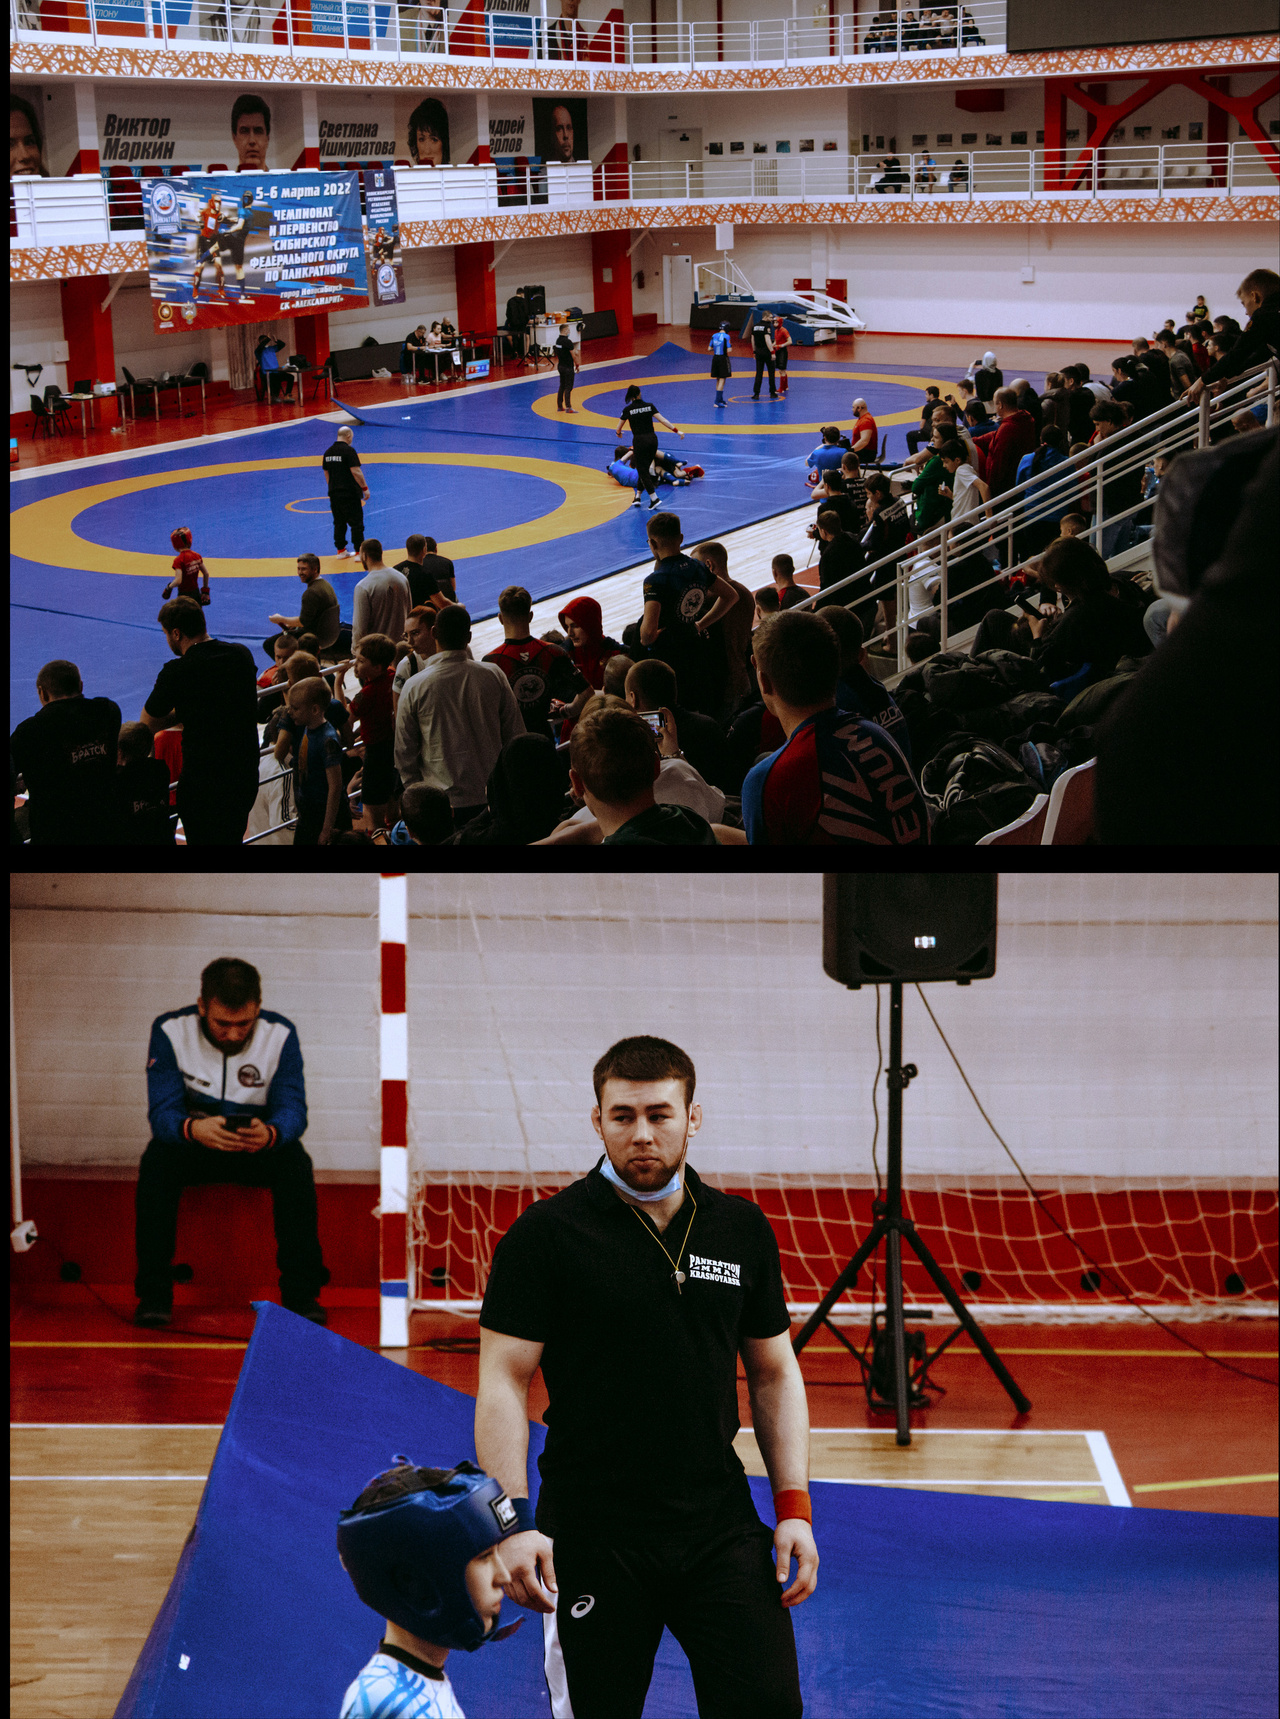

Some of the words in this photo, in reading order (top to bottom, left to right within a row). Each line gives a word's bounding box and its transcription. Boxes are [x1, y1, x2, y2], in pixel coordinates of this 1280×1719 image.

[335, 4, 369, 14] ПОЕДИТЕЛЬ
[104, 113, 172, 138] Виктор
[319, 120, 379, 138] Светлана
[489, 116, 525, 136] ндрей
[102, 138, 175, 162] Маркин
[319, 139, 396, 157] Ишмуратова
[489, 137, 523, 154] ерлов
[281, 186, 320, 200] марта
[323, 182, 351, 196] 2022
[274, 206, 334, 221] ЧЕМПИОНАТ
[269, 225, 277, 237] И
[280, 221, 339, 236] ПЕРВЕНСТВО
[274, 235, 336, 251] СИБИРСКОГО
[249, 251, 325, 268] ФЕДЕРАЛЬНОГО
[326, 247, 359, 261] ОКРУГА
[265, 270, 279, 282] ПО
[281, 262, 348, 281] ПАНКРАТИОНУ
[280, 289, 300, 299] город
[280, 302, 290, 310] СК
[72, 744, 107, 764] БРАТСК
[689, 1254, 741, 1279] PANKRATION
[690, 1270, 741, 1287] KRASNOYARSK
